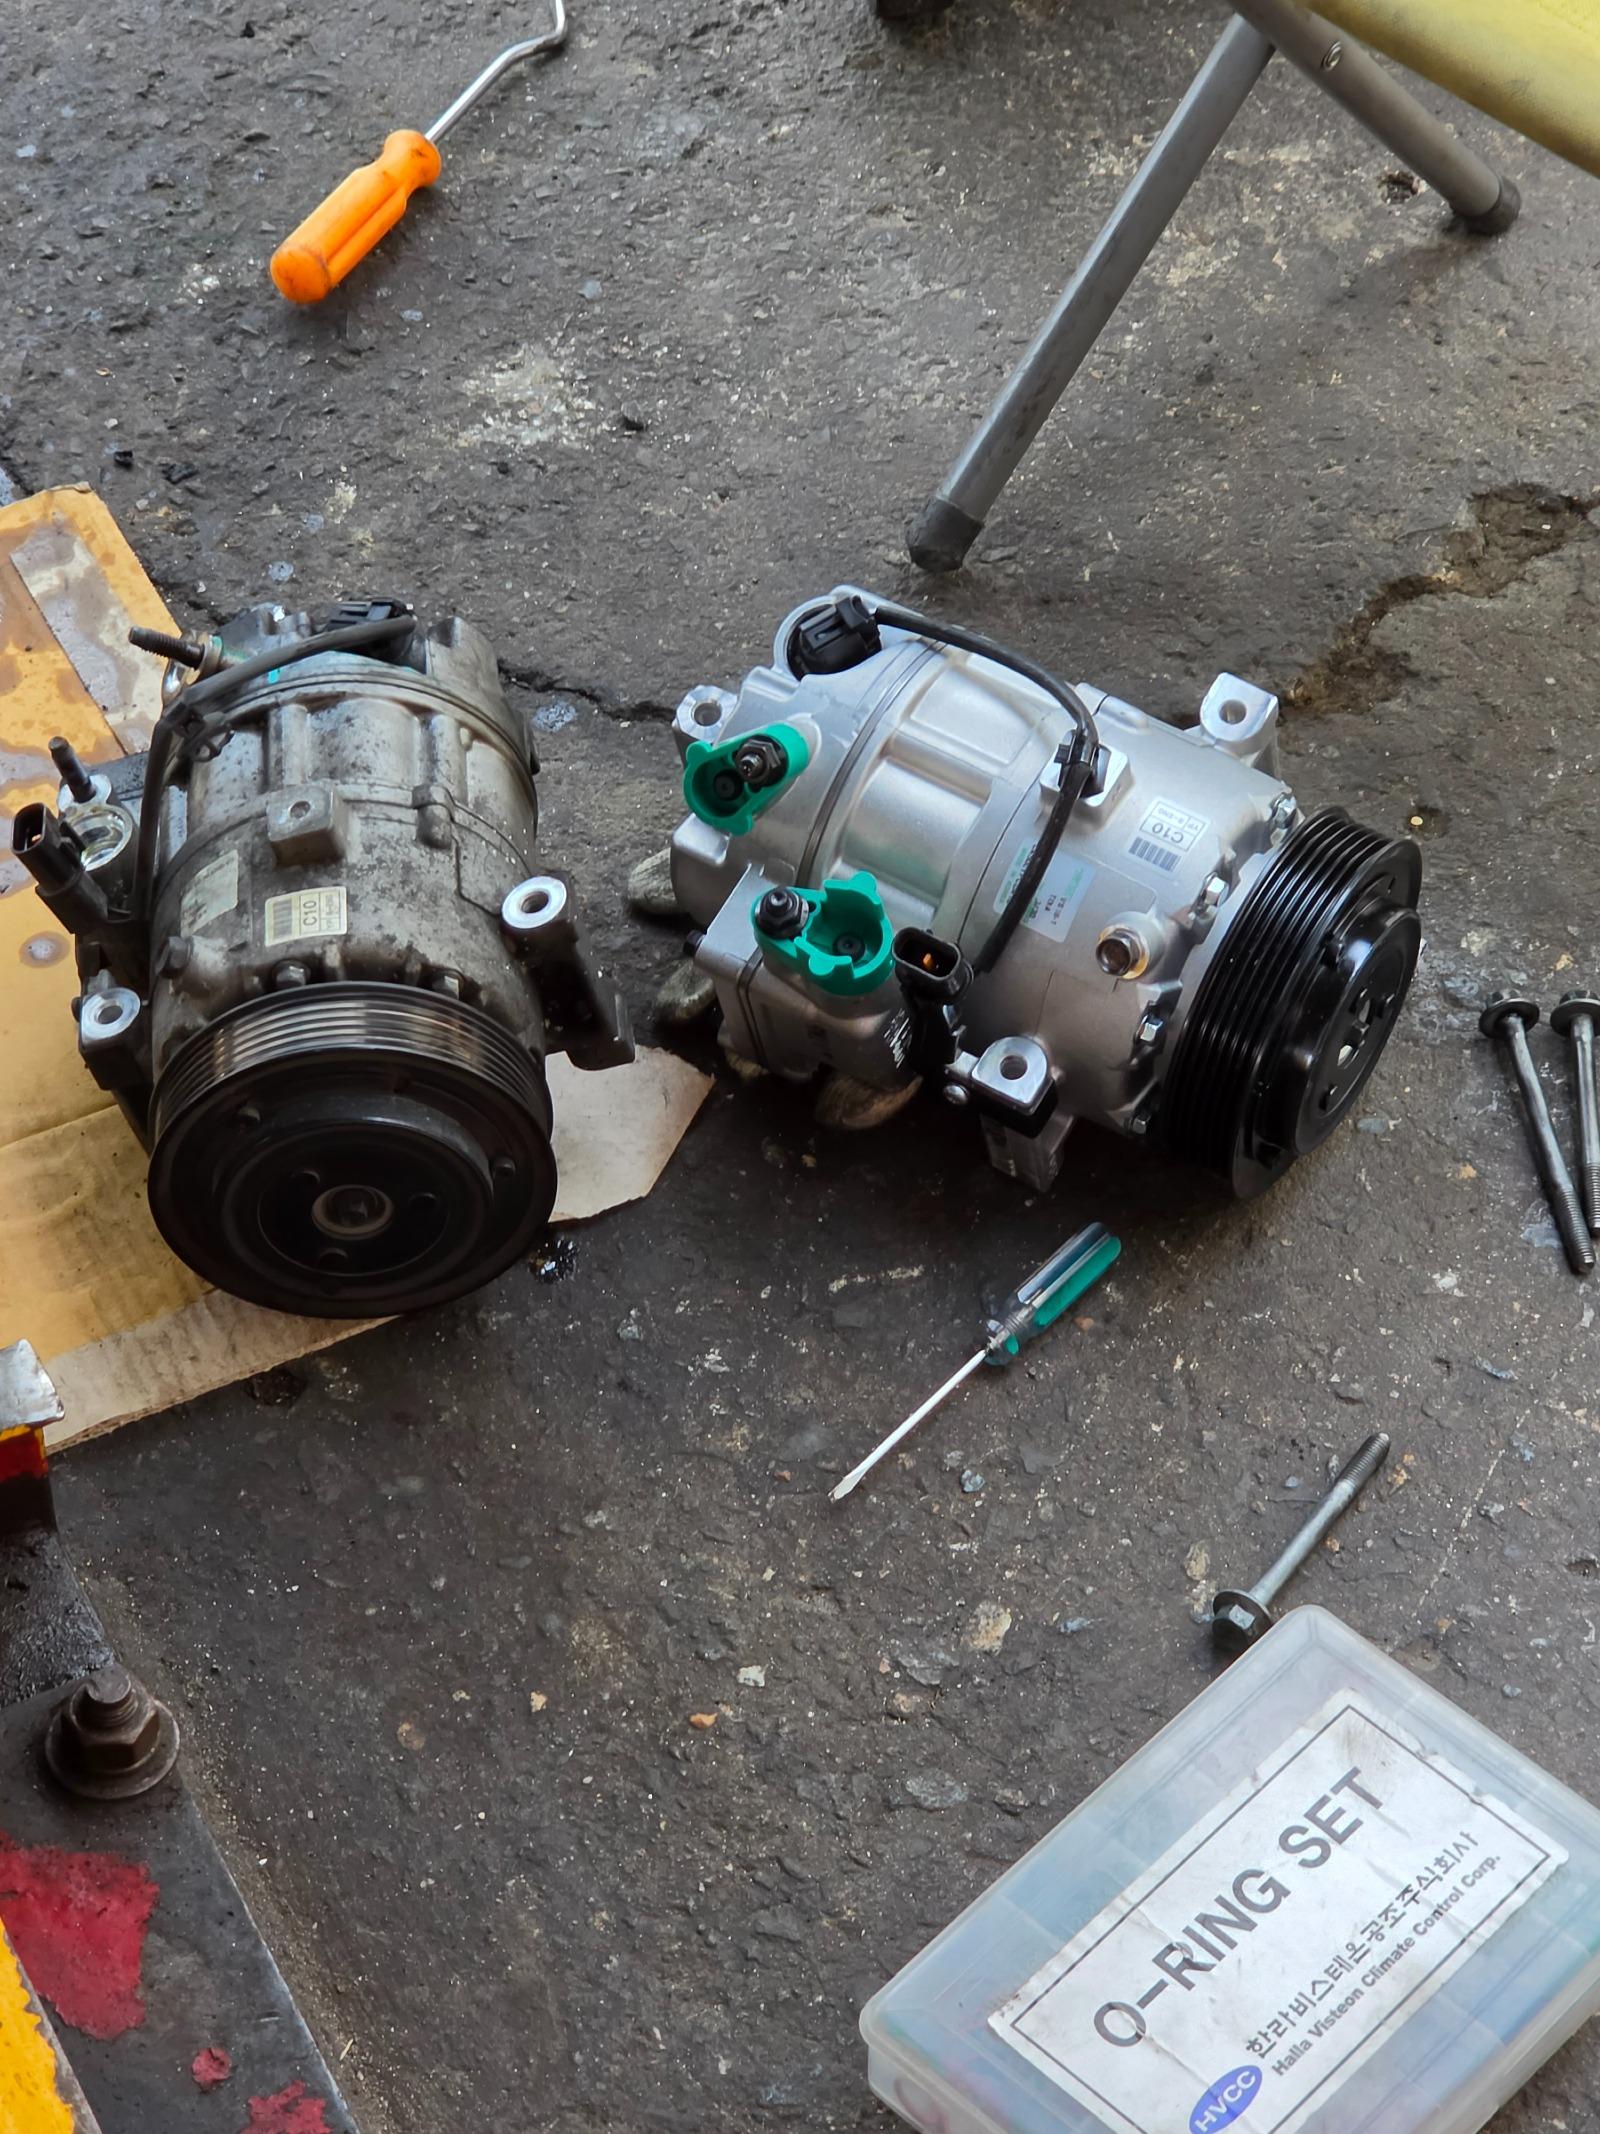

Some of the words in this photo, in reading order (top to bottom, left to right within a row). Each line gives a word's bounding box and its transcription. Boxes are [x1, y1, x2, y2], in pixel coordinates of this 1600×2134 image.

[1152, 822, 1184, 843] C10
[303, 900, 318, 926] C10
[1093, 1868, 1292, 2048] O-RING
[1277, 1766, 1384, 1869] SET
[1245, 1830, 1479, 2059] 한라비스테온공조주식회사
[1272, 2036, 1313, 2076] Halla
[1308, 1987, 1364, 2038] Visteon
[1361, 1935, 1416, 1988] Climate
[1412, 1886, 1466, 1937] Control
[1460, 1854, 1501, 1889] Corp.
[1194, 2070, 1256, 2133] HVCC
